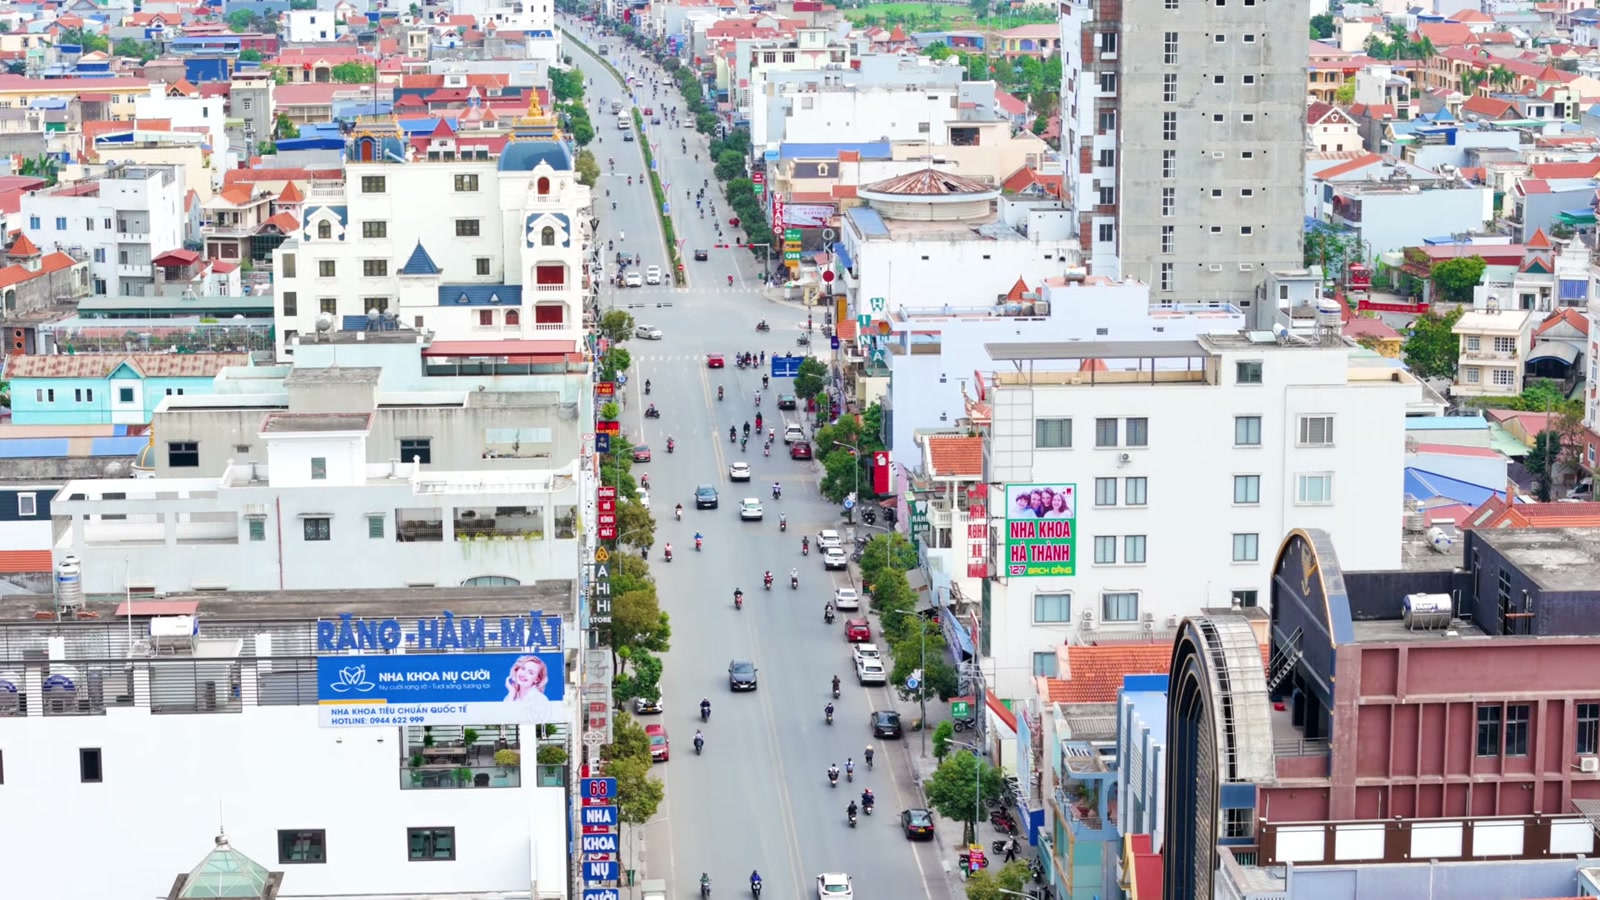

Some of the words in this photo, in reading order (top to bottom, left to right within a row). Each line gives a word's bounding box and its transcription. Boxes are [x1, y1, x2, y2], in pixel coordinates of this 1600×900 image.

[1010, 521, 1035, 538] NHA
[1039, 521, 1071, 538] KHOA
[1011, 541, 1027, 562] HÀ
[1031, 541, 1070, 562] THÀNH
[597, 565, 608, 577] A
[1009, 565, 1027, 575] 127
[379, 672, 404, 682] NHA
[407, 672, 440, 681] KHOA
[442, 671, 458, 683] NỤ
[461, 668, 490, 680] CƯỜI
[379, 705, 395, 714] TIÊU
[430, 704, 456, 713] QUỐC
[459, 704, 468, 713] TẾ
[331, 717, 367, 725] HOTLINE:
[392, 716, 408, 724] 622
[589, 780, 608, 796] 68
[586, 809, 611, 823] NHA
[583, 837, 615, 850] KHOA
[591, 863, 609, 879] NỤ
